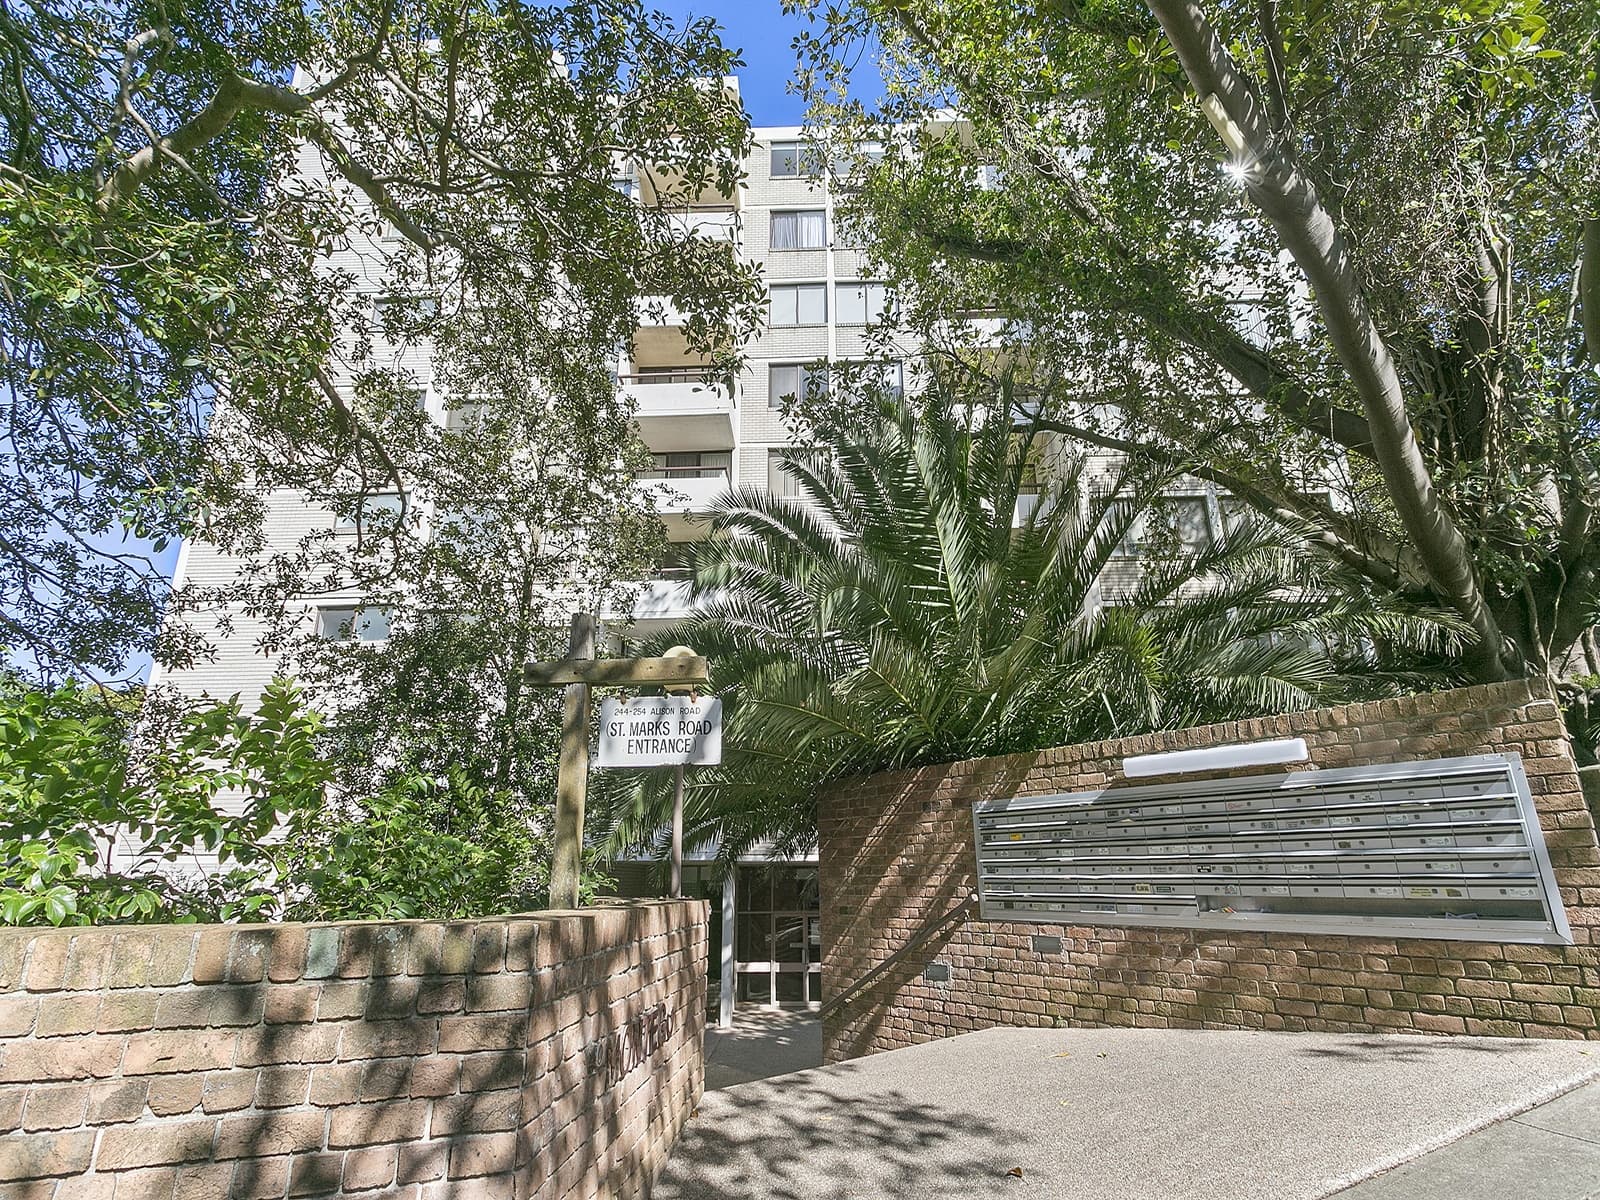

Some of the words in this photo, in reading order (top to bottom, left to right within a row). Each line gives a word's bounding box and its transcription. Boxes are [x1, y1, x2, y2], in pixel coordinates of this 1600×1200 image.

[614, 707, 646, 716] 244-254
[650, 707, 675, 715] ALISON
[680, 707, 701, 715] ROAD
[605, 721, 626, 737] (ST.
[629, 720, 671, 737] MARKS
[678, 720, 712, 736] ROAD
[627, 738, 697, 755] ENTRANCE)
